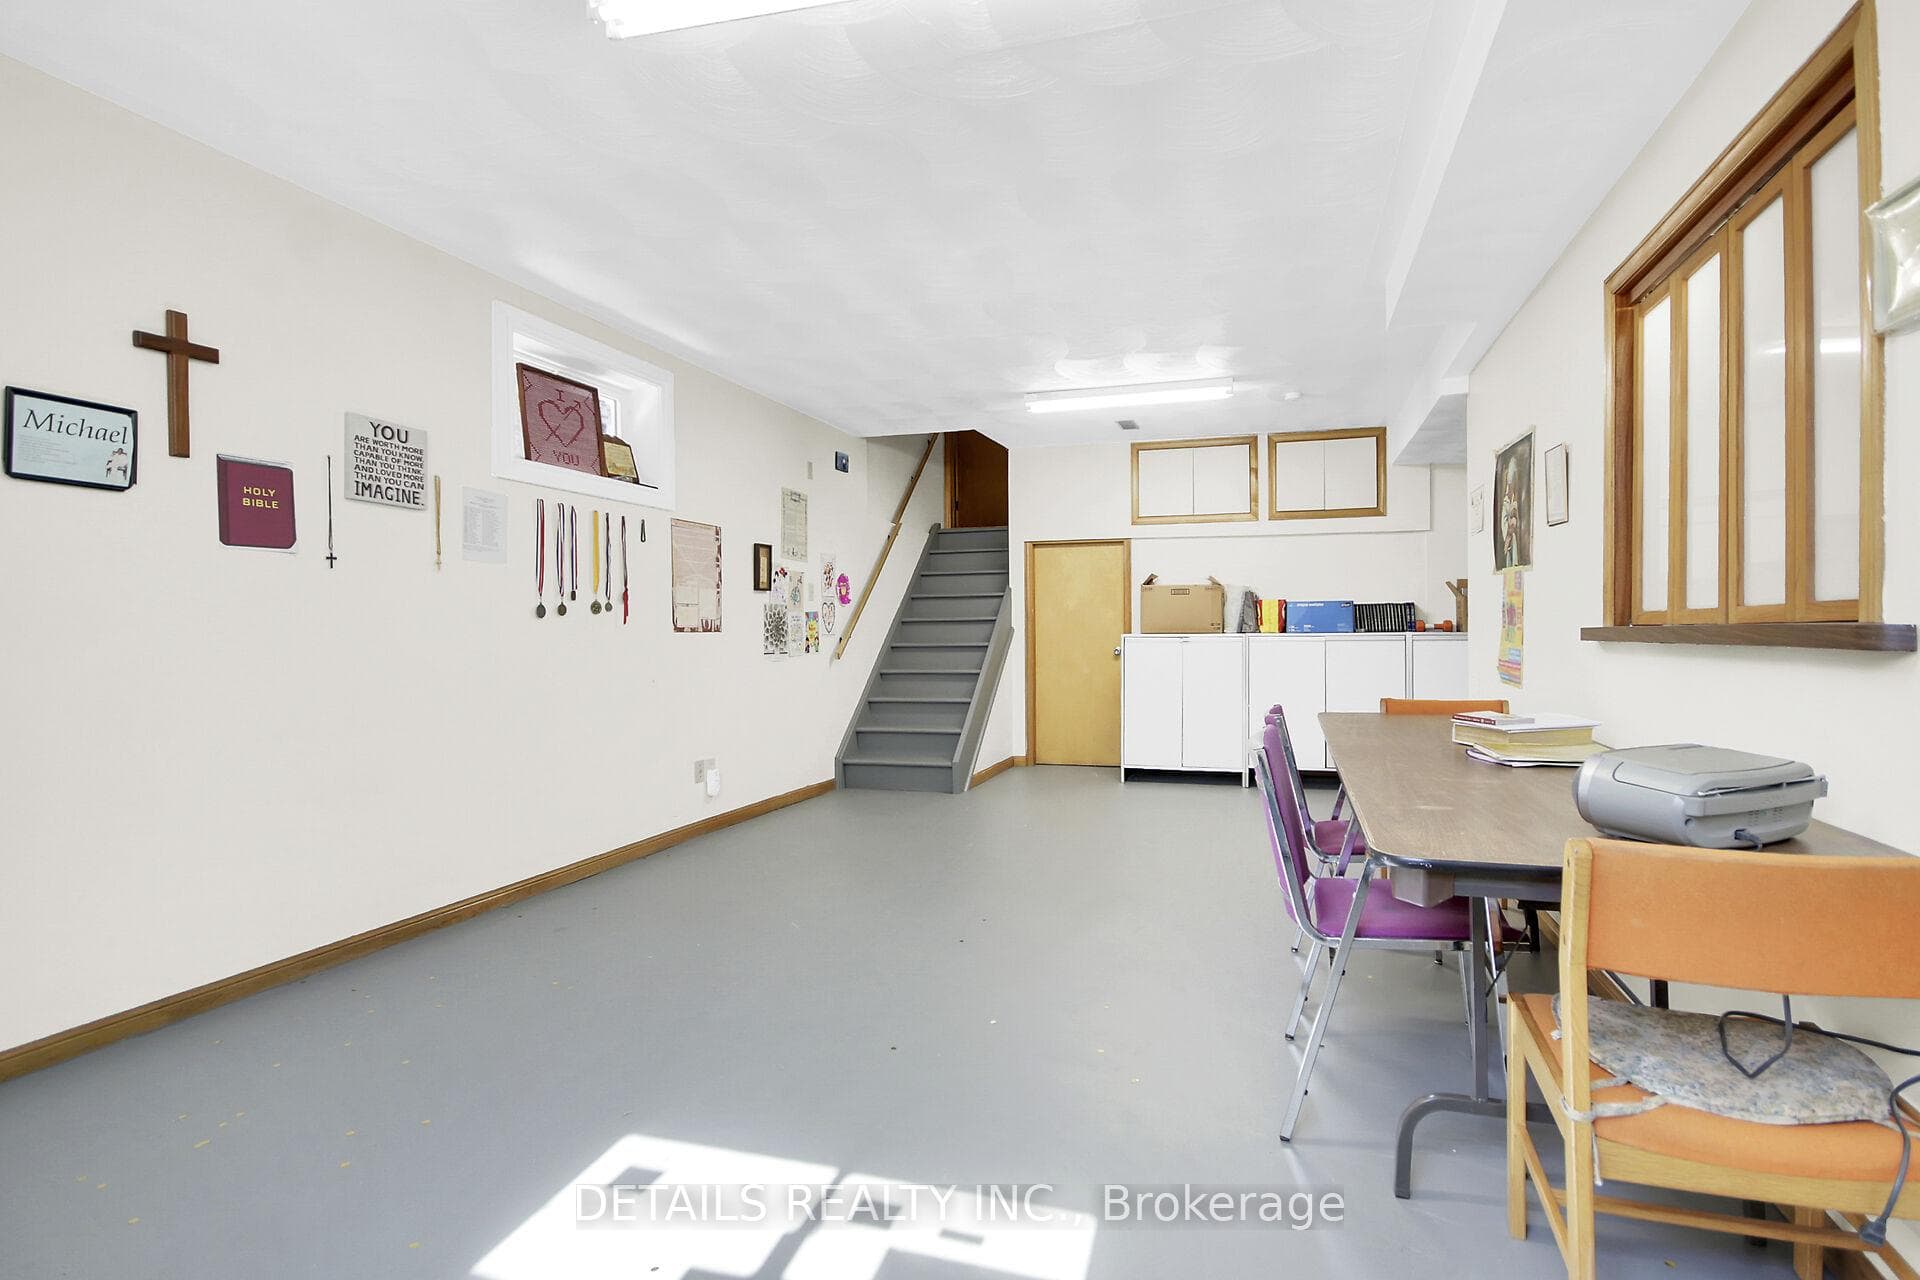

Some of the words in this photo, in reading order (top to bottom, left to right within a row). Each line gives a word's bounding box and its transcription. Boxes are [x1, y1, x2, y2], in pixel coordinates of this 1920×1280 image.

[555, 388, 565, 403] I
[23, 408, 128, 445] Michael
[369, 422, 408, 443] YOU
[354, 435, 370, 443] ARE
[373, 439, 399, 450] WORTH
[402, 446, 423, 455] MORE
[354, 442, 378, 453] THAN
[381, 448, 397, 456] YOU
[354, 450, 389, 462] CAPABLE
[404, 460, 423, 469] MORE
[354, 457, 377, 466] THAN
[380, 462, 394, 470] YOU
[553, 449, 580, 467] YOU
[354, 464, 373, 473] AND
[376, 468, 402, 478] LOVED
[404, 474, 423, 482] MORE
[354, 471, 380, 482] THAN
[384, 477, 401, 486] YOU
[404, 481, 424, 490] CAN
[243, 486, 276, 497] HOLY
[355, 480, 424, 506] IMAGINE.
[242, 498, 279, 509] BIBLE
